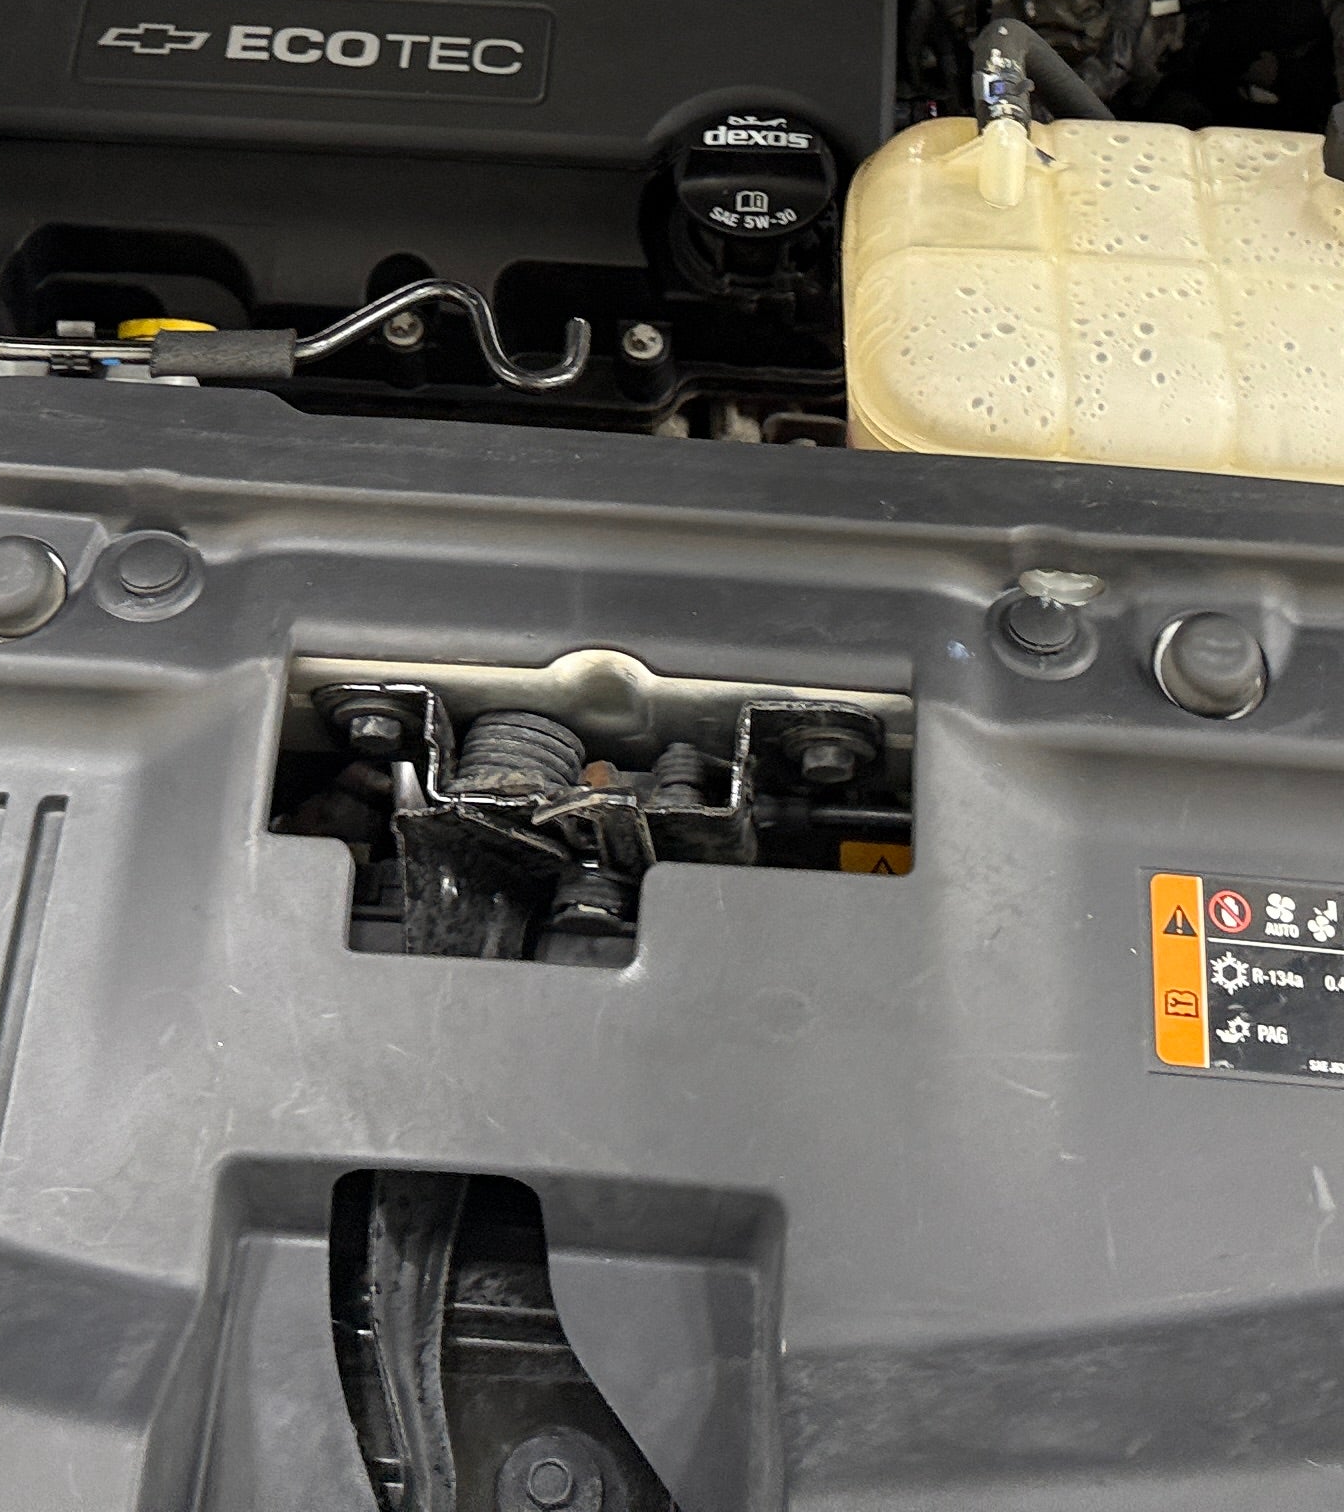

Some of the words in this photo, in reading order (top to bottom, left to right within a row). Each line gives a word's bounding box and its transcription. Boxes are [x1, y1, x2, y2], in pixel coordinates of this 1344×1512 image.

[225, 25, 524, 75] ECOTEC
[703, 125, 813, 149] dexos
[709, 206, 740, 227] SAE
[743, 208, 797, 229] 5W-30
[1265, 922, 1300, 939] AUTO
[1252, 967, 1305, 989] R-134a
[1257, 1024, 1289, 1045] PAG
